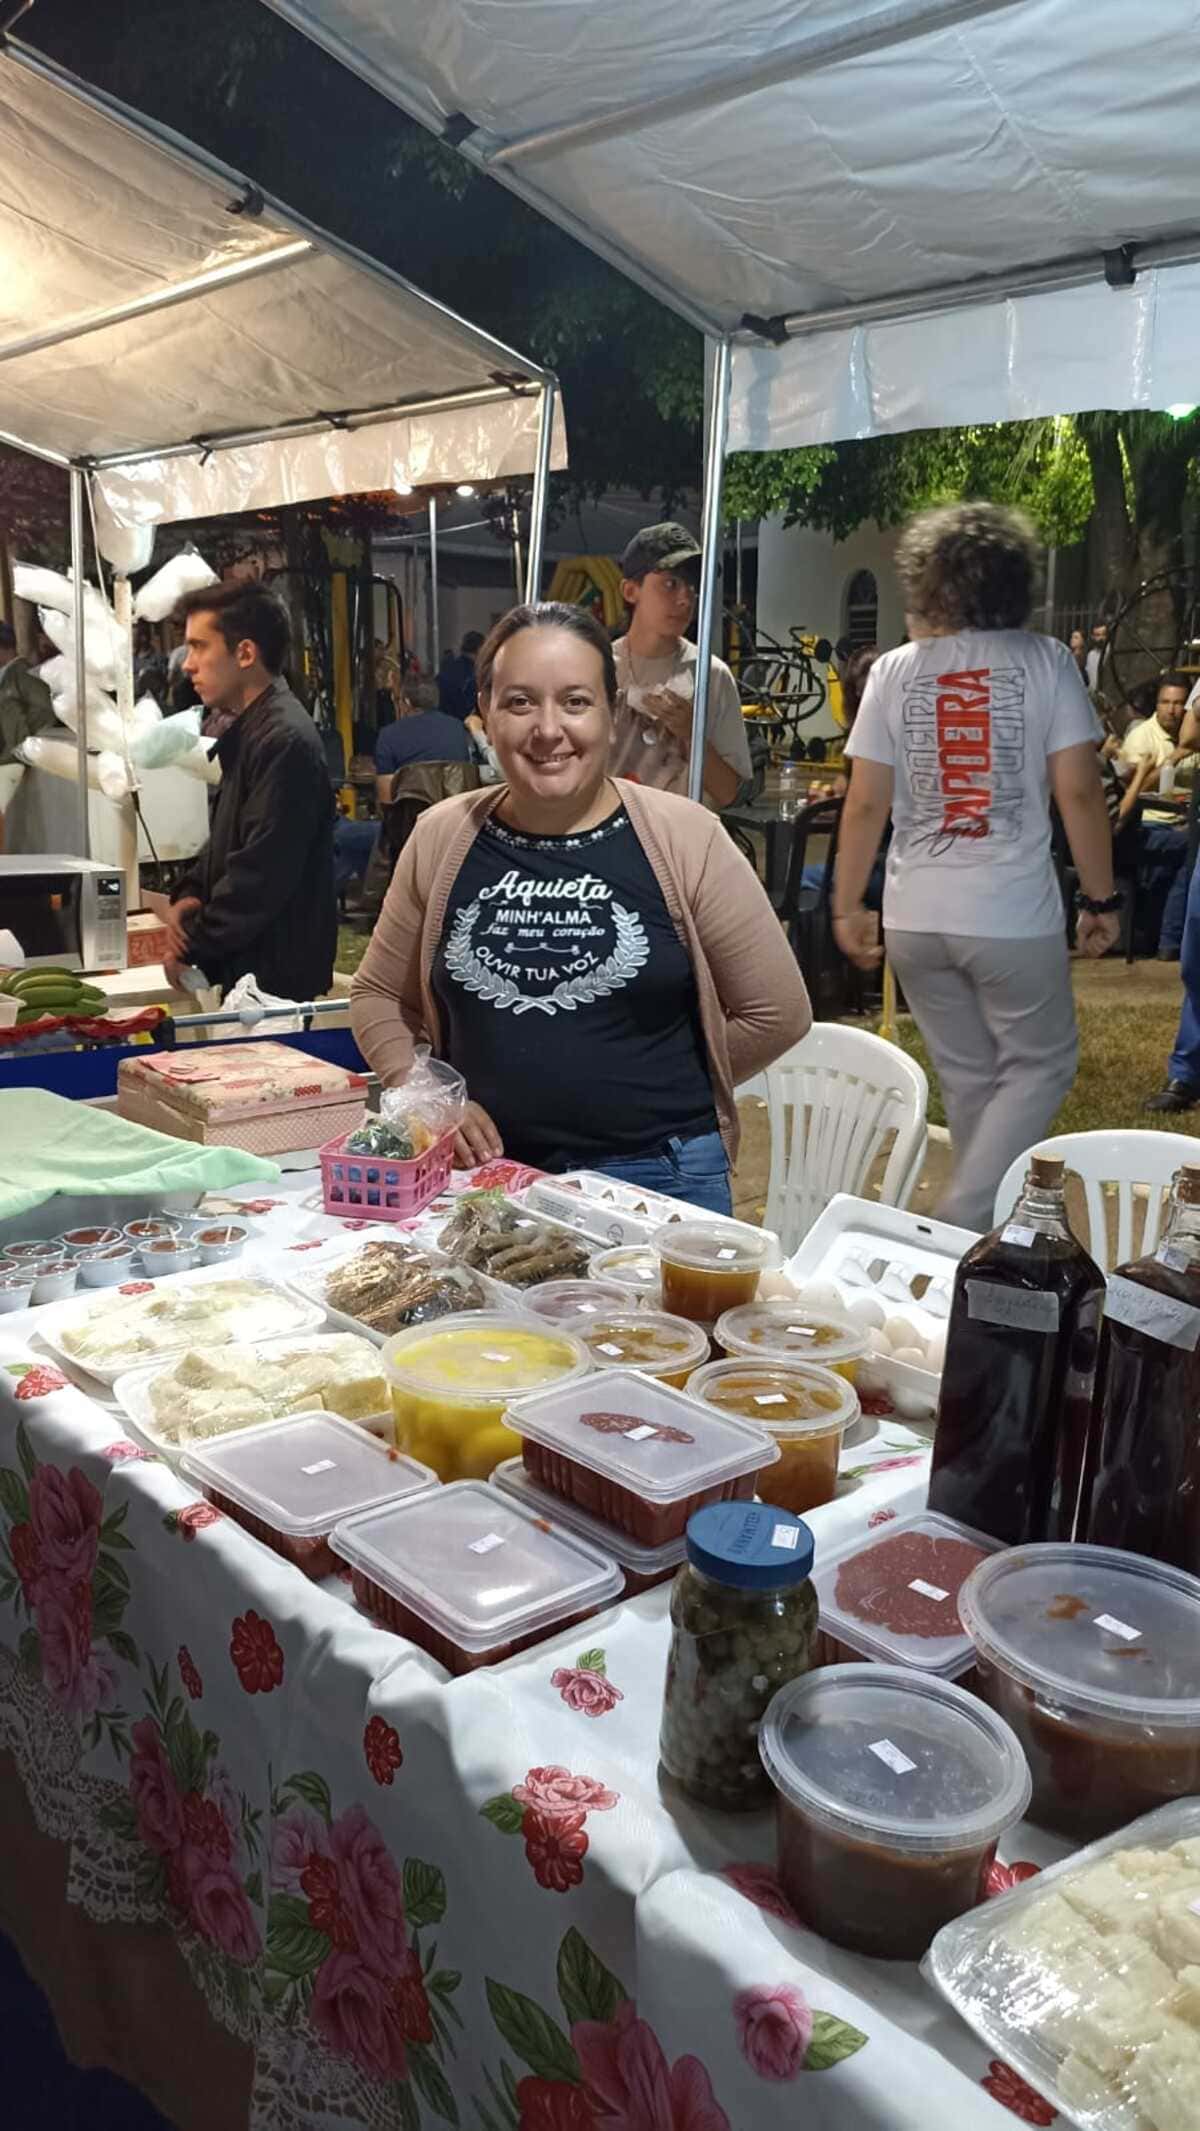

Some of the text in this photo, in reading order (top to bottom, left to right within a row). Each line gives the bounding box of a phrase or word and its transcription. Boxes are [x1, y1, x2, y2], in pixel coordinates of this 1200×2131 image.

[936, 668, 991, 838] CAPOEIRA
[478, 870, 613, 906] Aquieta
[480, 923, 606, 938] faz meu coração
[495, 909, 592, 925] MINH'ALMA
[475, 945, 600, 981] OUVIR TUA VOZ
